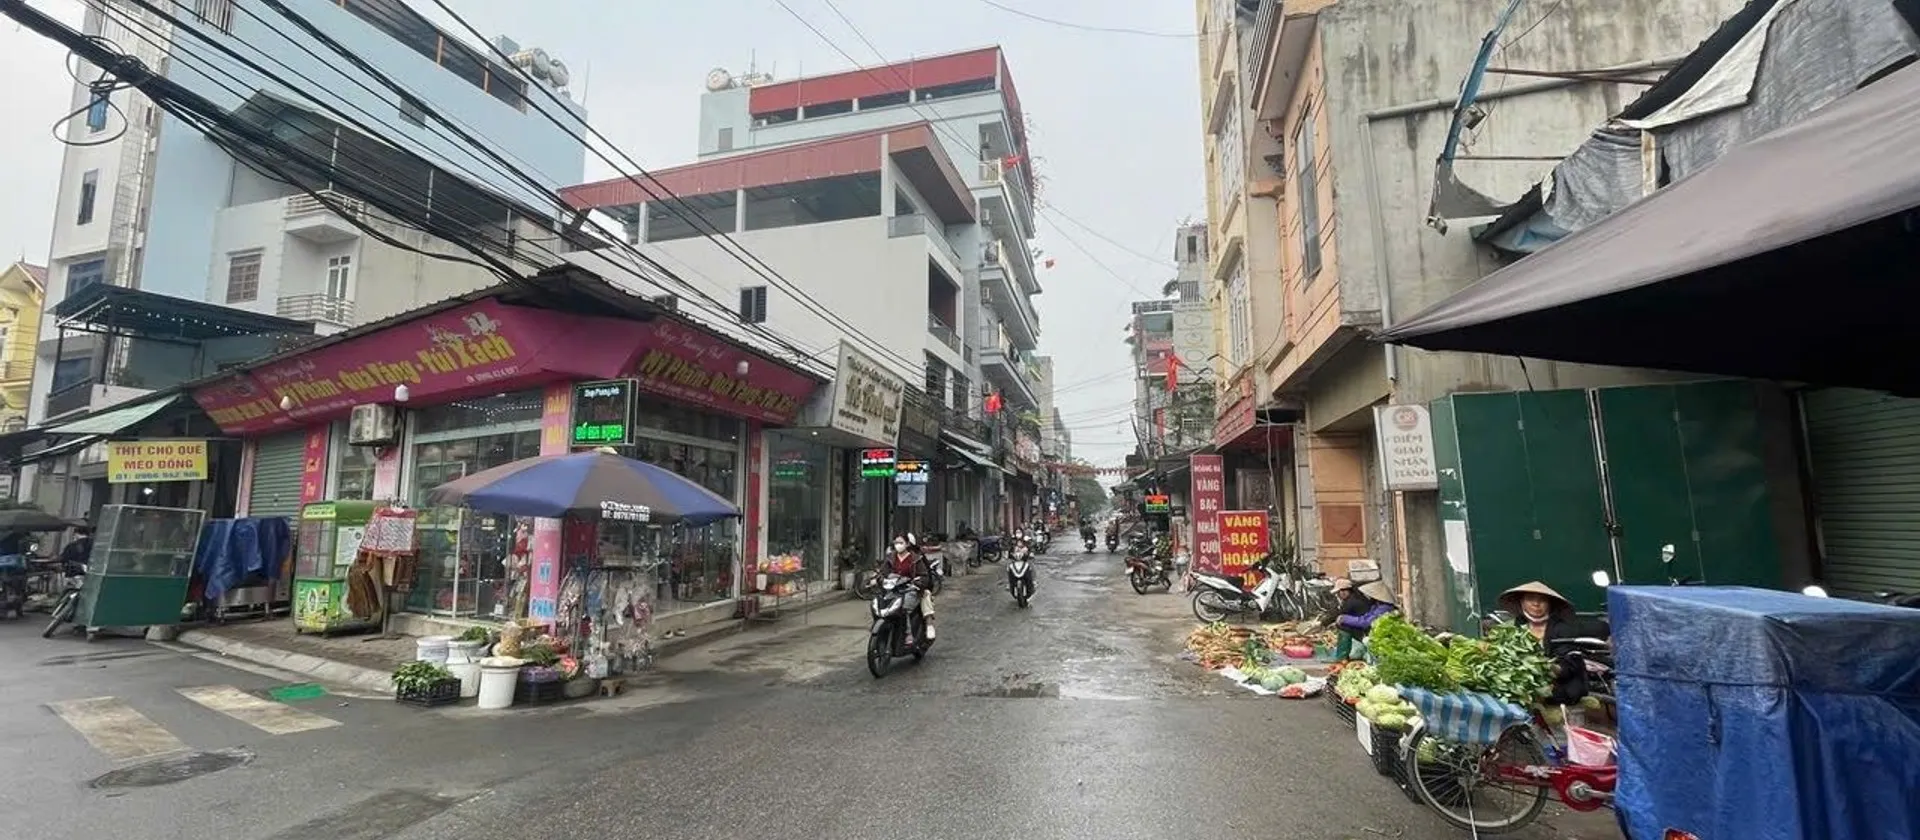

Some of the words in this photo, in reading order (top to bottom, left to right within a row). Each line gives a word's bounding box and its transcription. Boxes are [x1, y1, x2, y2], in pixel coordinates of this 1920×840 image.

[115, 445, 142, 457] THỊT
[1196, 478, 1220, 492] VÀNG
[1199, 498, 1218, 513] BẠC
[1224, 514, 1262, 528] VÀNG
[1231, 532, 1259, 549] BẠC
